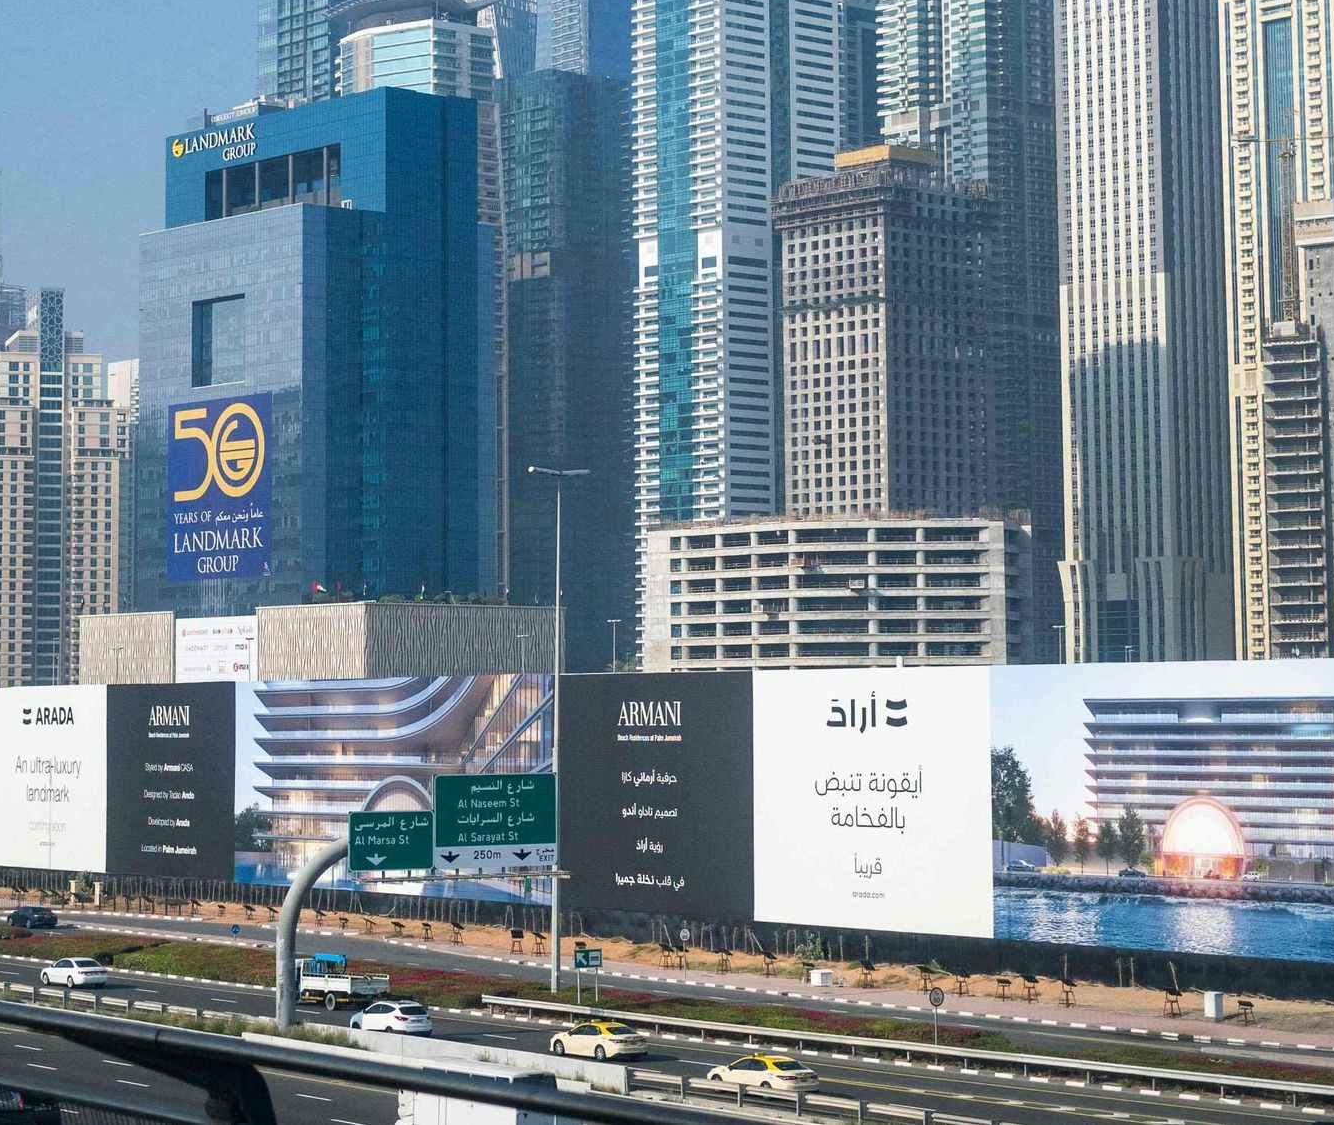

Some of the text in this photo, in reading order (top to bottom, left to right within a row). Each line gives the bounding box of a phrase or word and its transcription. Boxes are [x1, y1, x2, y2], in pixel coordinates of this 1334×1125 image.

[236, 106, 258, 118] GROUP
[185, 123, 255, 154] LANDMARK
[222, 142, 257, 161] GROUP
[174, 510, 212, 525] YEARS OF
[215, 511, 231, 525] معكم
[174, 526, 263, 554] LANDMARK
[197, 555, 239, 574] GROUP
[35, 707, 74, 725] ARADA
[148, 705, 190, 726] ARMANI
[617, 701, 681, 726] ARMANI
[15, 756, 82, 779] An ultra-luxury
[145, 763, 193, 773] Styled by Armani CASA
[470, 779, 535, 795] شارع النسيم
[814, 764, 923, 799] أيقونة تنبض
[26, 784, 70, 803] landmark
[143, 790, 163, 800] Designed
[163, 790, 168, 800] by
[182, 791, 194, 800] Ando
[458, 798, 519, 809] Al Naseem St
[148, 817, 190, 828] Developed by Arada
[400, 818, 429, 832] شارع
[457, 812, 535, 826] شارع السرايات
[831, 806, 906, 834] بالفخامة
[354, 834, 410, 846] Al Marsa St
[458, 831, 519, 843] Al Sarayat St
[141, 845, 158, 853] Located
[162, 846, 175, 854] Palm
[175, 847, 197, 855] Jumeirah
[473, 850, 502, 860] 250m
[539, 854, 554, 862] EXIT
[656, 873, 672, 887] قلب
[673, 876, 685, 891] في
[852, 890, 885, 899] arada.com
